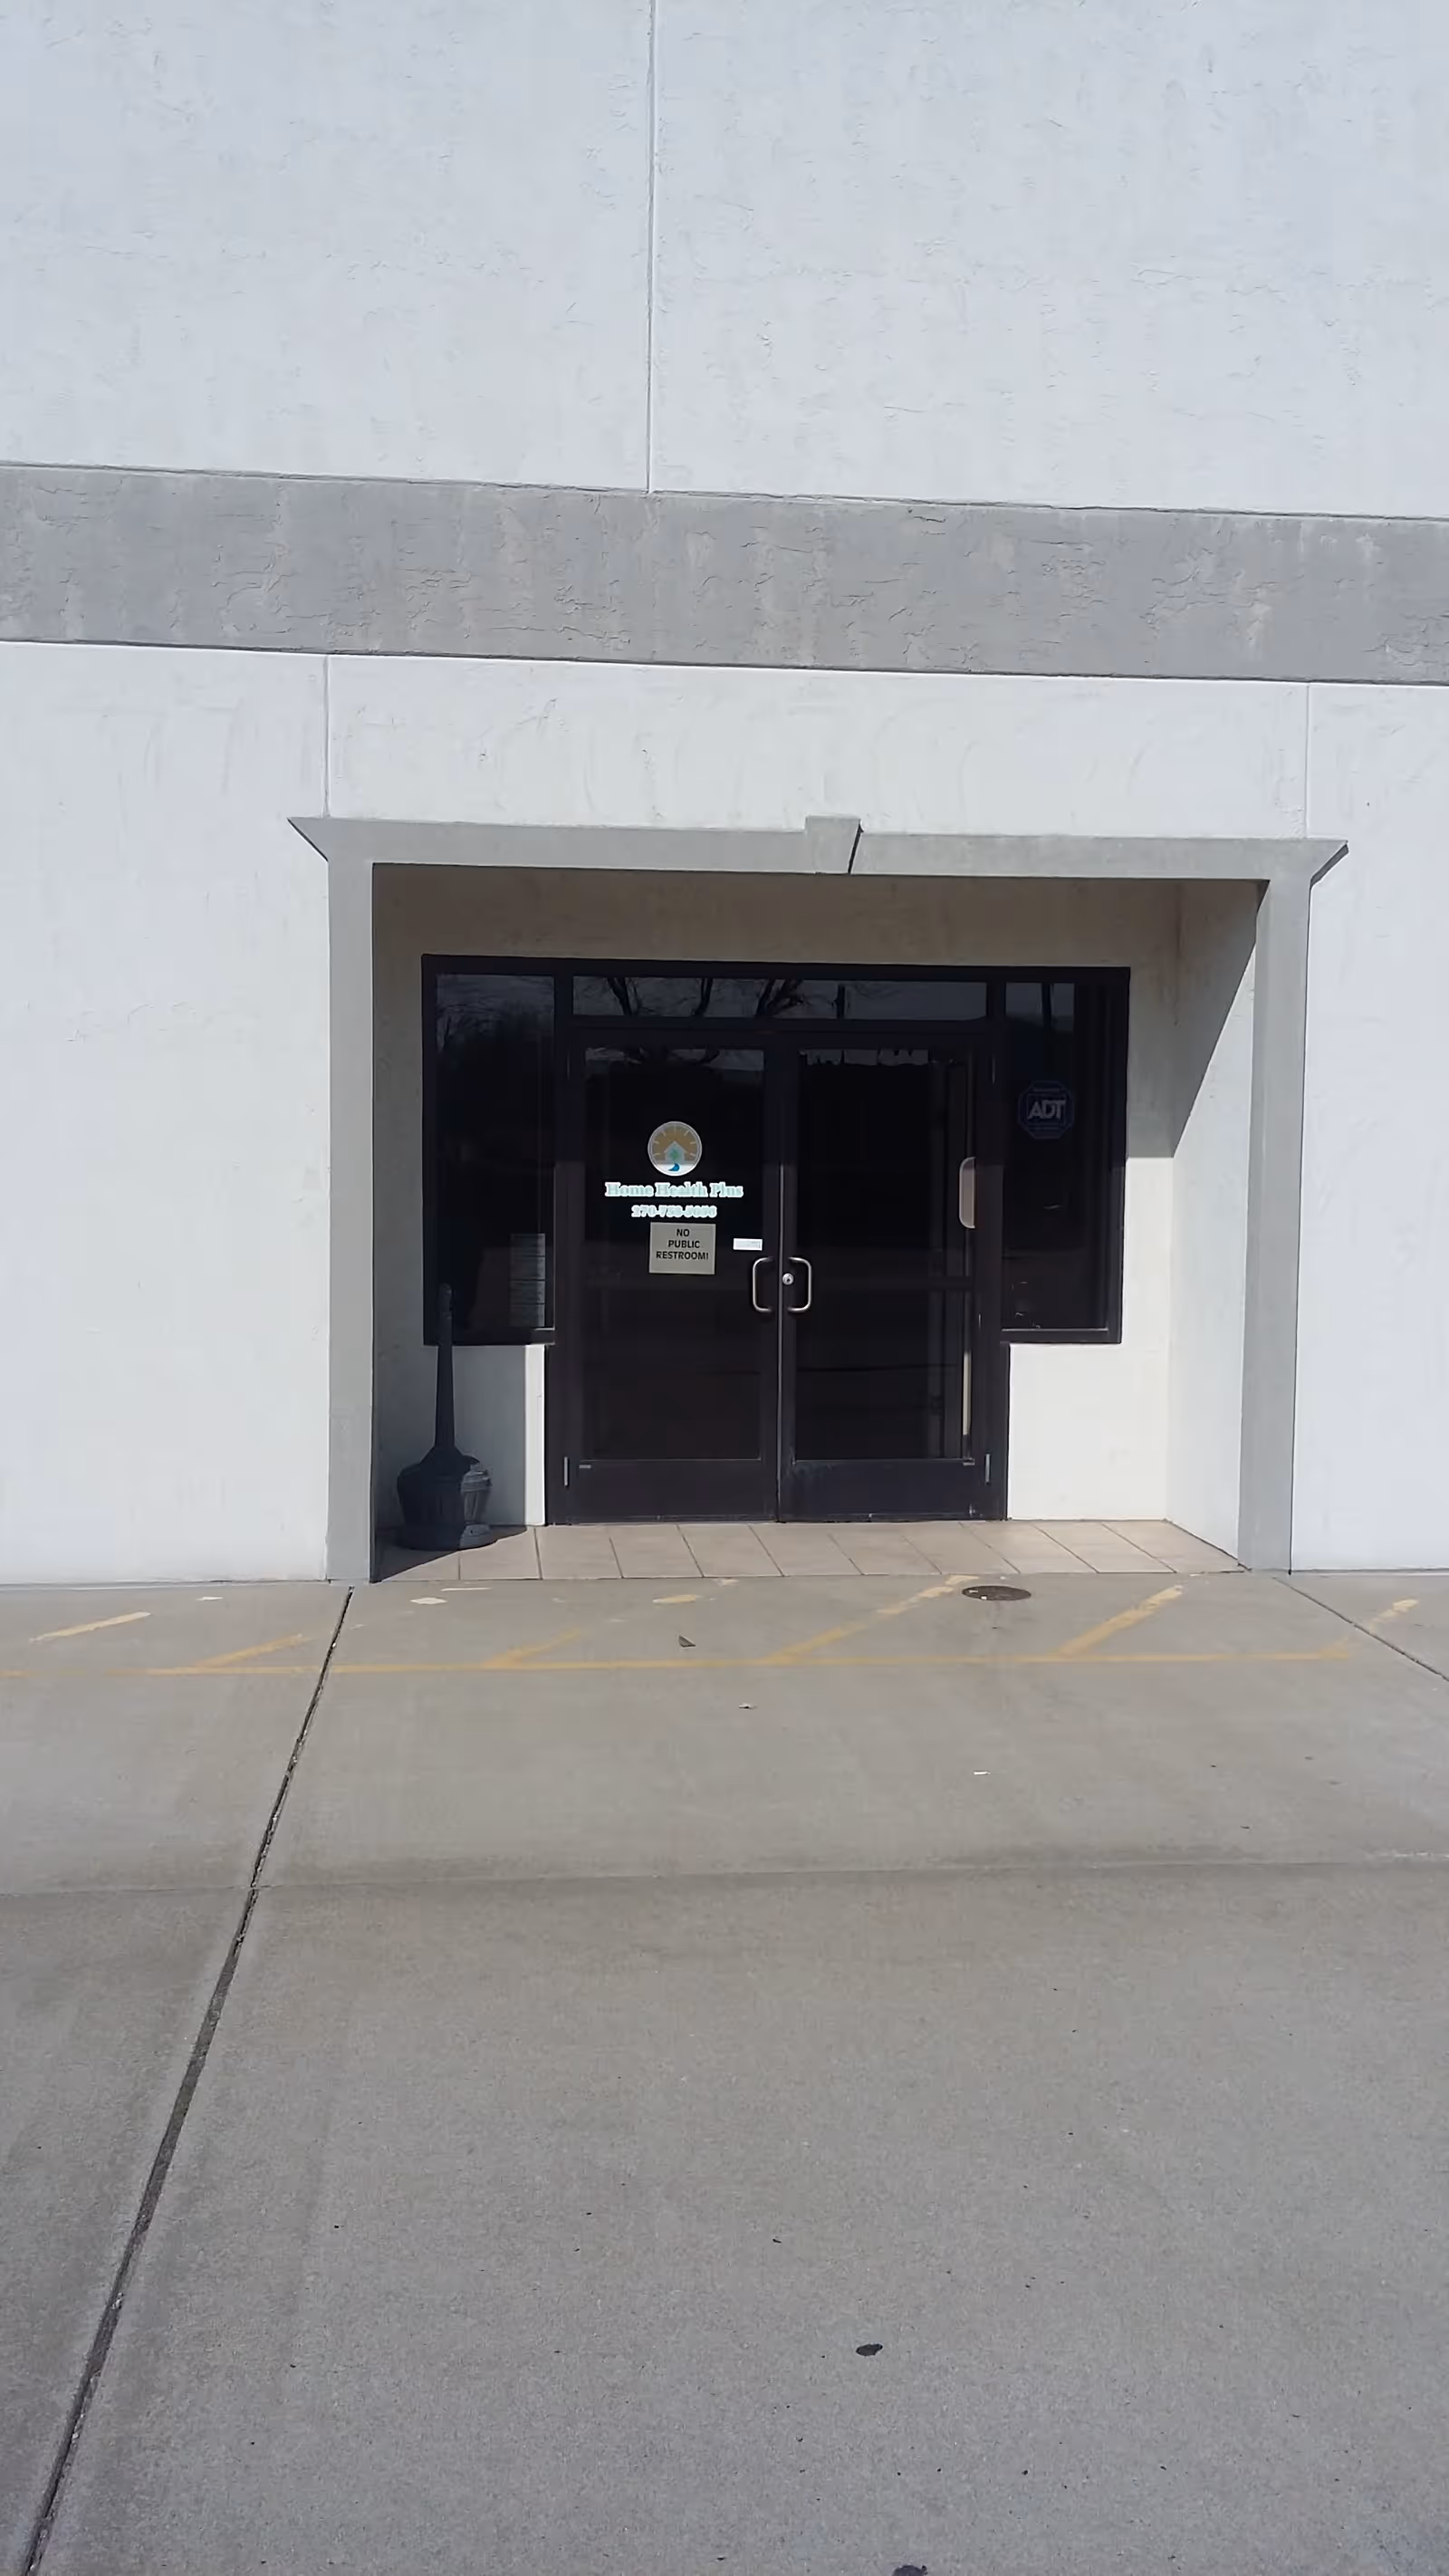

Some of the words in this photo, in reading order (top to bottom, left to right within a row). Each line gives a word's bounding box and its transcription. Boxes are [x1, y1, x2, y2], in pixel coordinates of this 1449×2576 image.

[1027, 1100, 1065, 1120] ADT
[605, 1181, 654, 1197] Home
[655, 1181, 708, 1197] Health
[709, 1181, 744, 1197] Plus
[676, 1228, 690, 1237] NO
[667, 1239, 701, 1249] PUBLIC
[656, 1251, 709, 1260] RESTROOM!
